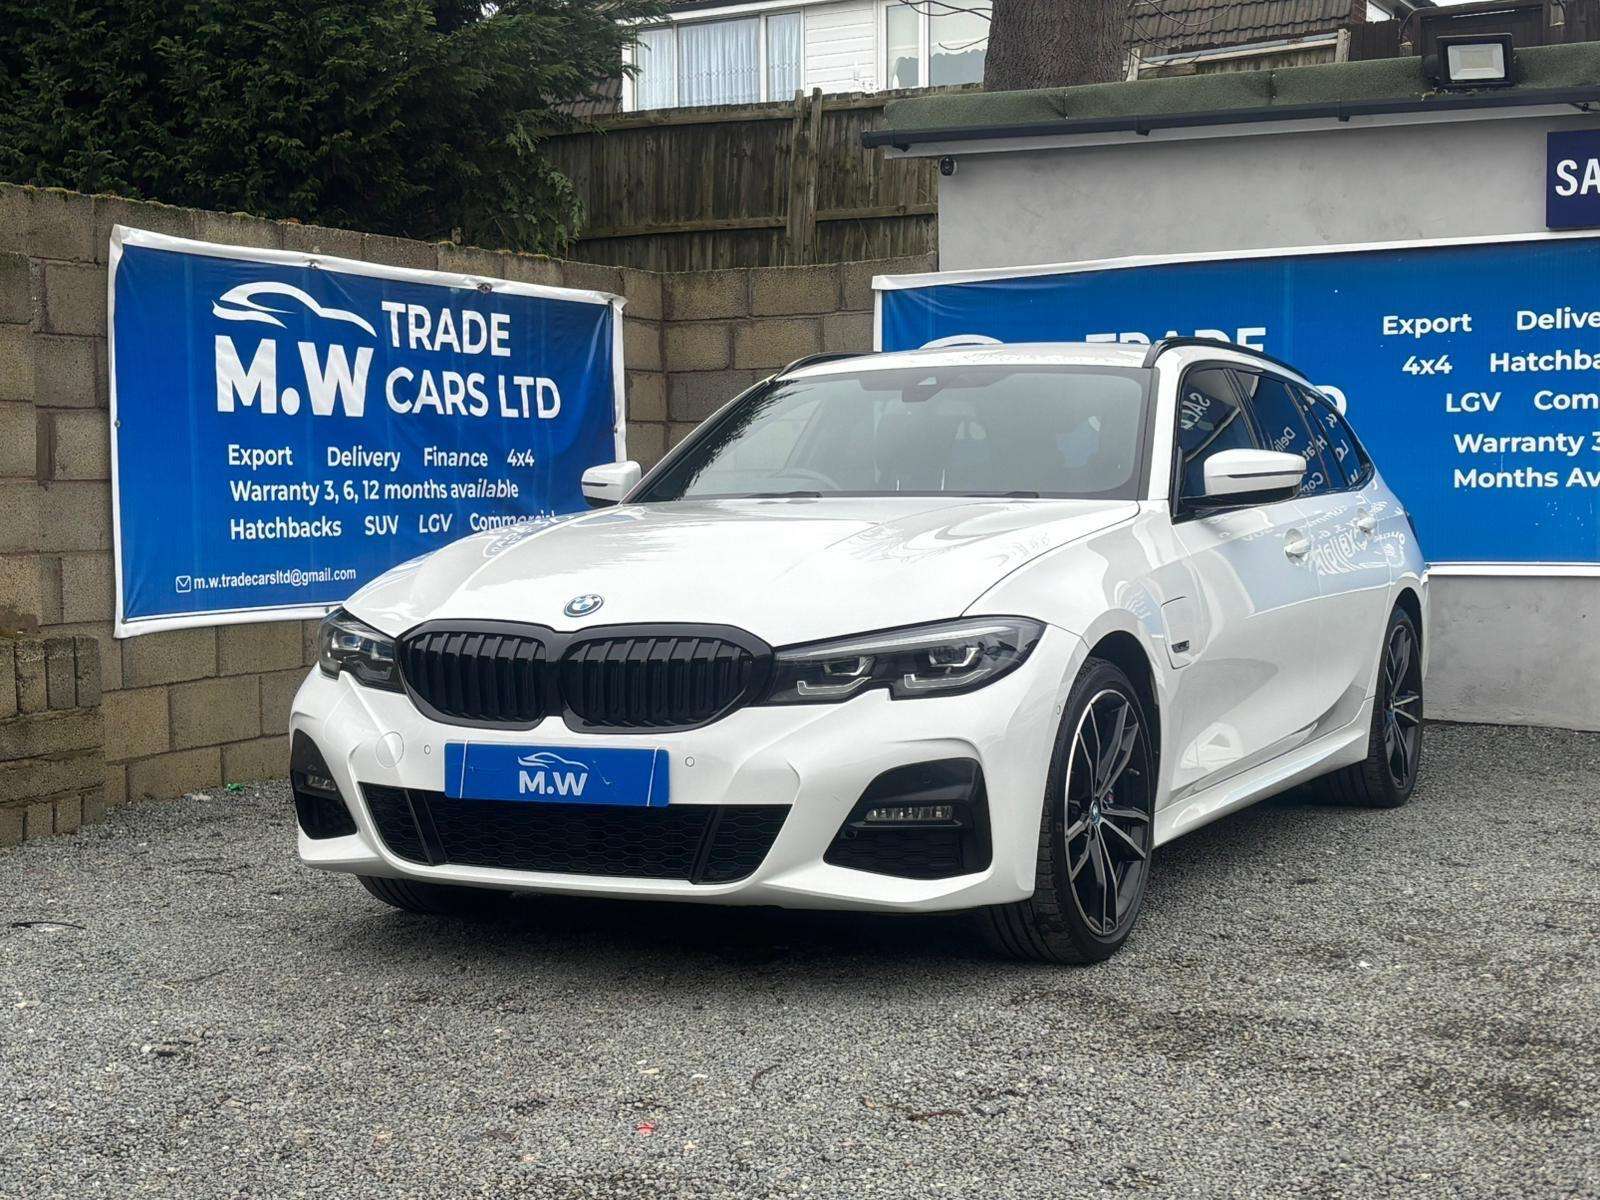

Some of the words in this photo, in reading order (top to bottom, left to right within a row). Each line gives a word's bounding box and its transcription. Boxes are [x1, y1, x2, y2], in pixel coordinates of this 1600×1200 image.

[382, 301, 510, 357] TRADE
[1383, 313, 1472, 338] Export
[214, 335, 374, 418] M.W
[1402, 355, 1453, 374] 4x4
[386, 367, 489, 417] CARS
[498, 375, 561, 419] LTD
[1447, 391, 1502, 412] LGV
[228, 443, 294, 470] Export
[328, 445, 400, 472] Delivery
[424, 446, 489, 467] Finance
[506, 449, 535, 467] 4x4
[1454, 432, 1585, 457] Warranty
[1454, 466, 1558, 488] Months
[230, 480, 320, 505] Warranty
[324, 480, 338, 505] 3,
[344, 480, 358, 504] 6,
[363, 480, 380, 500] 12
[385, 478, 448, 500] months
[451, 478, 519, 499] available
[231, 515, 342, 540] Hatchbacks
[364, 514, 399, 536] SUV
[418, 513, 453, 534] LGV
[193, 567, 357, 590] m.w.tradecarsltd@gmail.com
[519, 770, 588, 796] M.W
